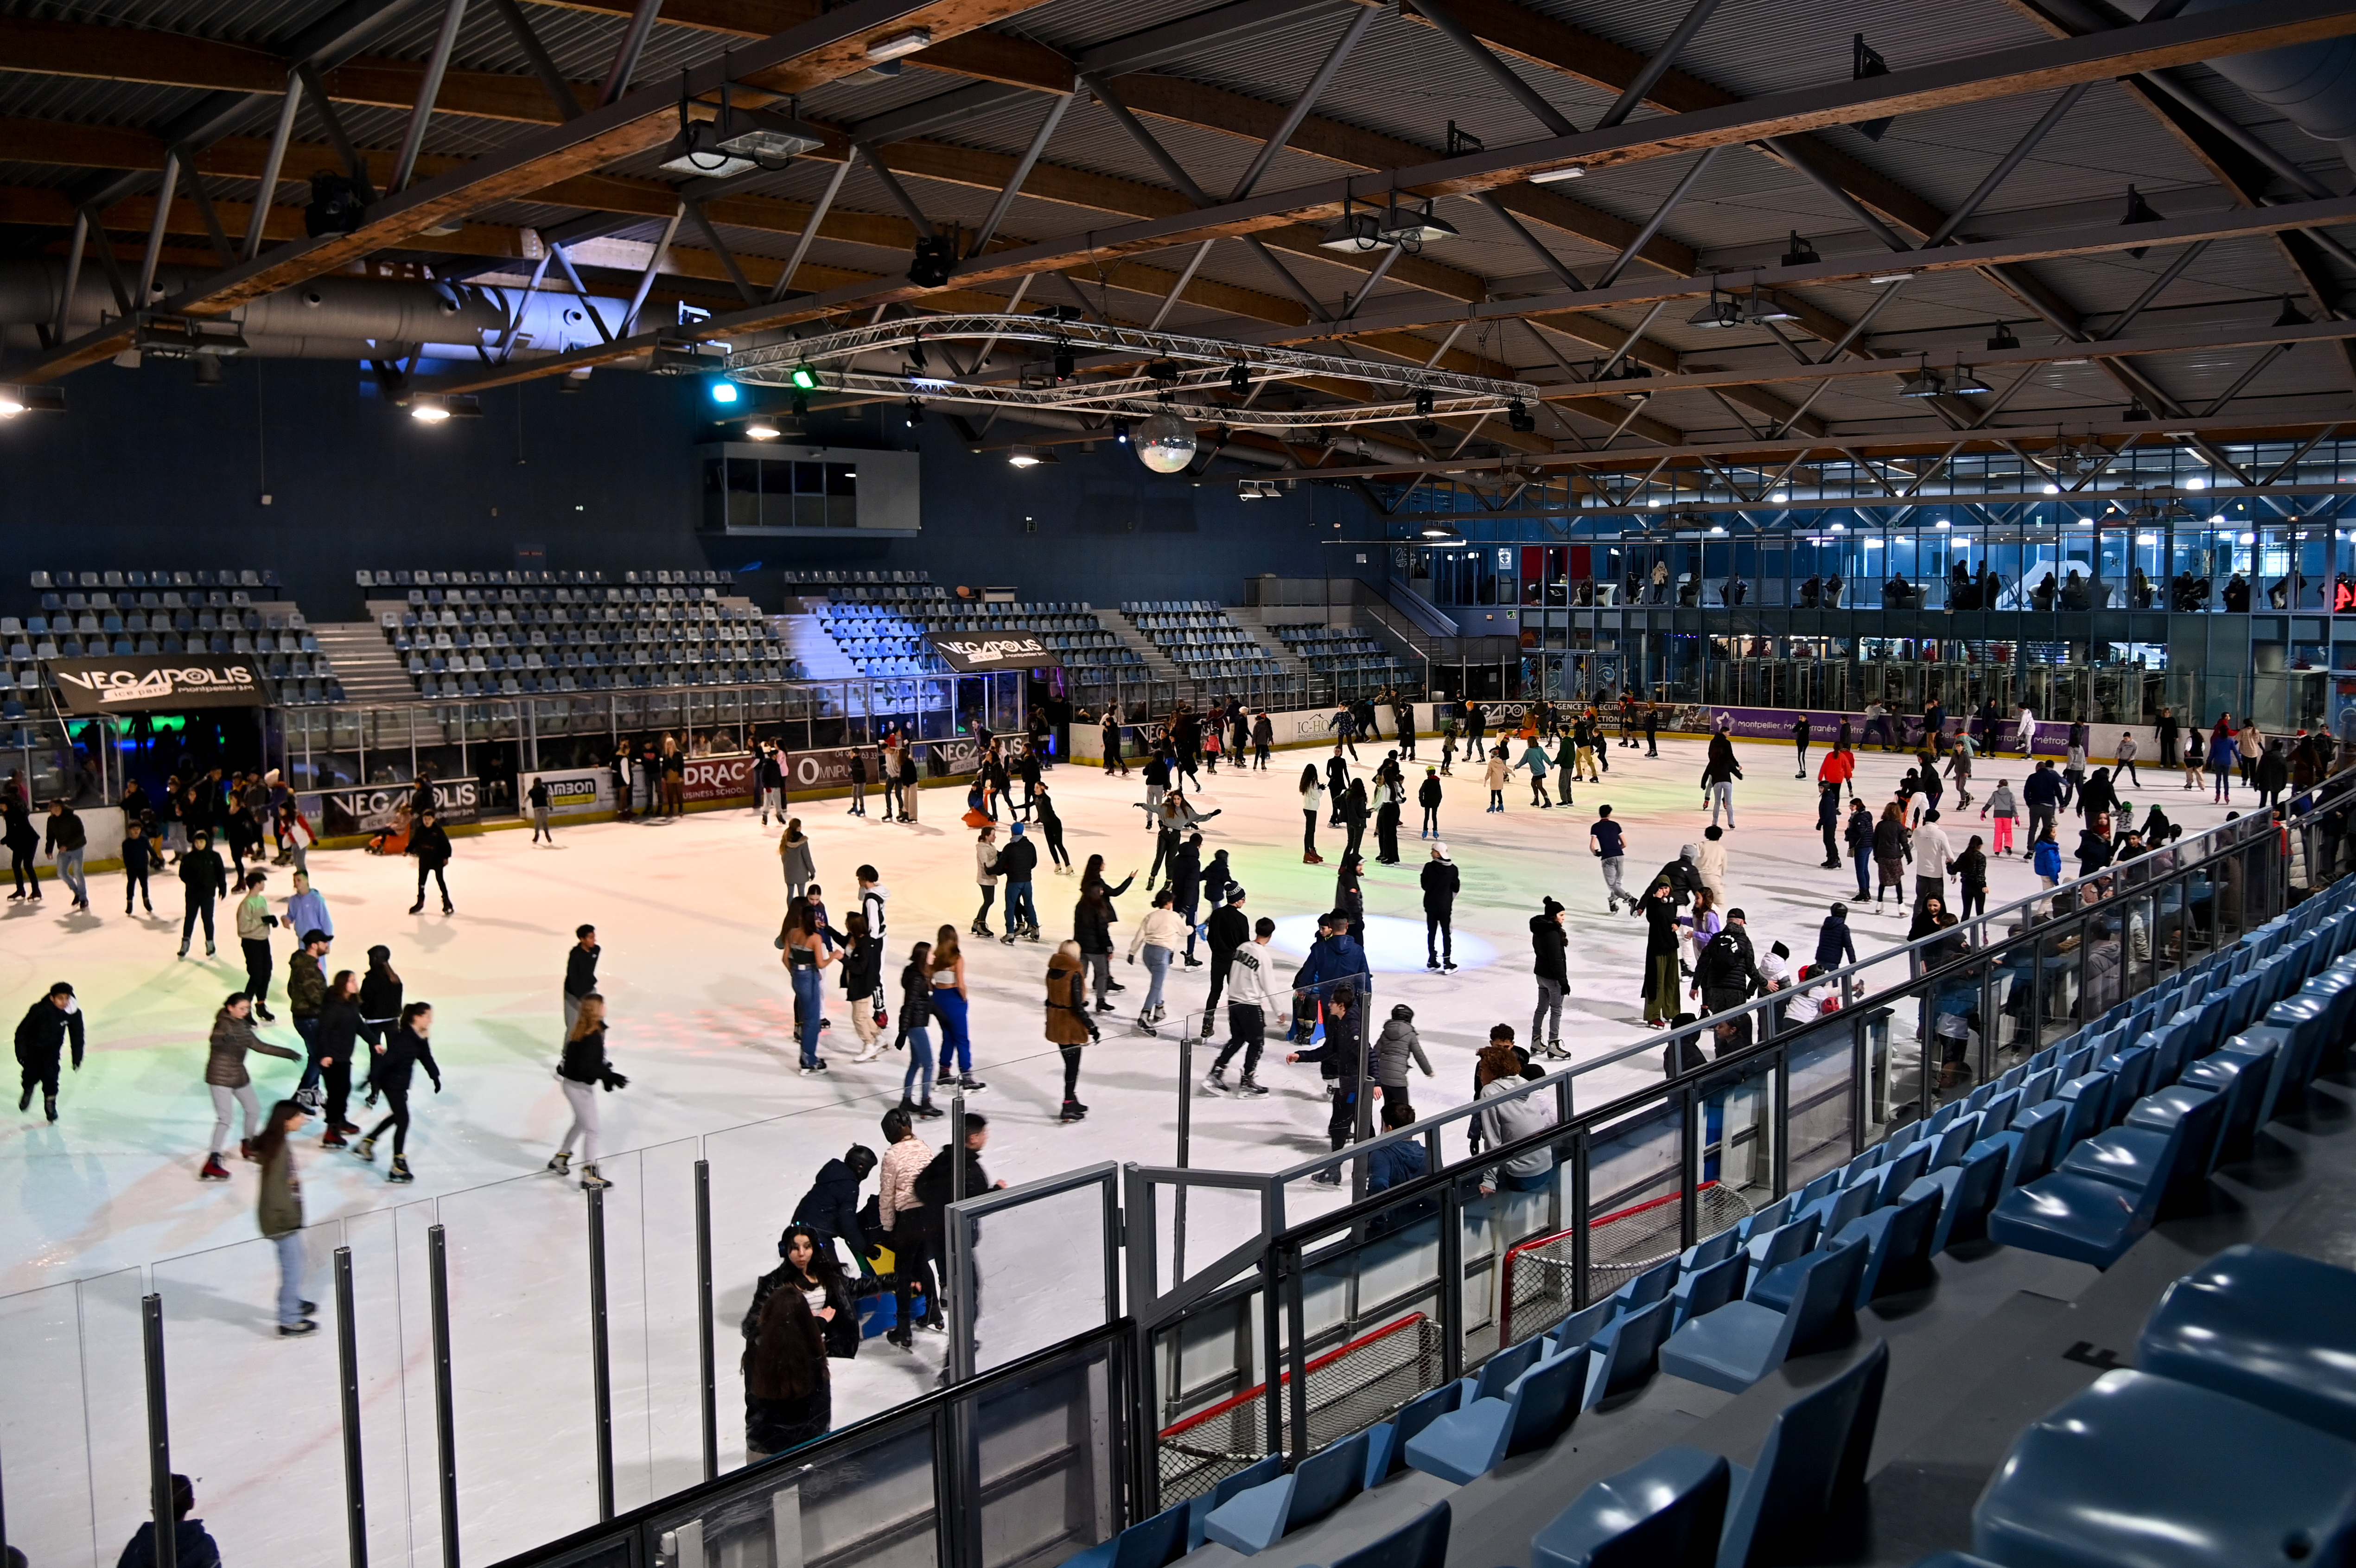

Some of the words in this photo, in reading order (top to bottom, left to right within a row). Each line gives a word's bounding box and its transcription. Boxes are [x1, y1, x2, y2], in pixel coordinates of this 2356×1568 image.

[937, 639, 1042, 654] VEGAPOLIS
[58, 666, 253, 689] VEGAPOLIS
[114, 689, 135, 698] ice
[138, 686, 168, 697] parc
[2033, 736, 2069, 746] métrop
[684, 762, 745, 788] DRAC
[332, 784, 476, 816] VEGAOLIS
[683, 789, 714, 799] USINESS
[715, 787, 746, 797] SCHOOL
